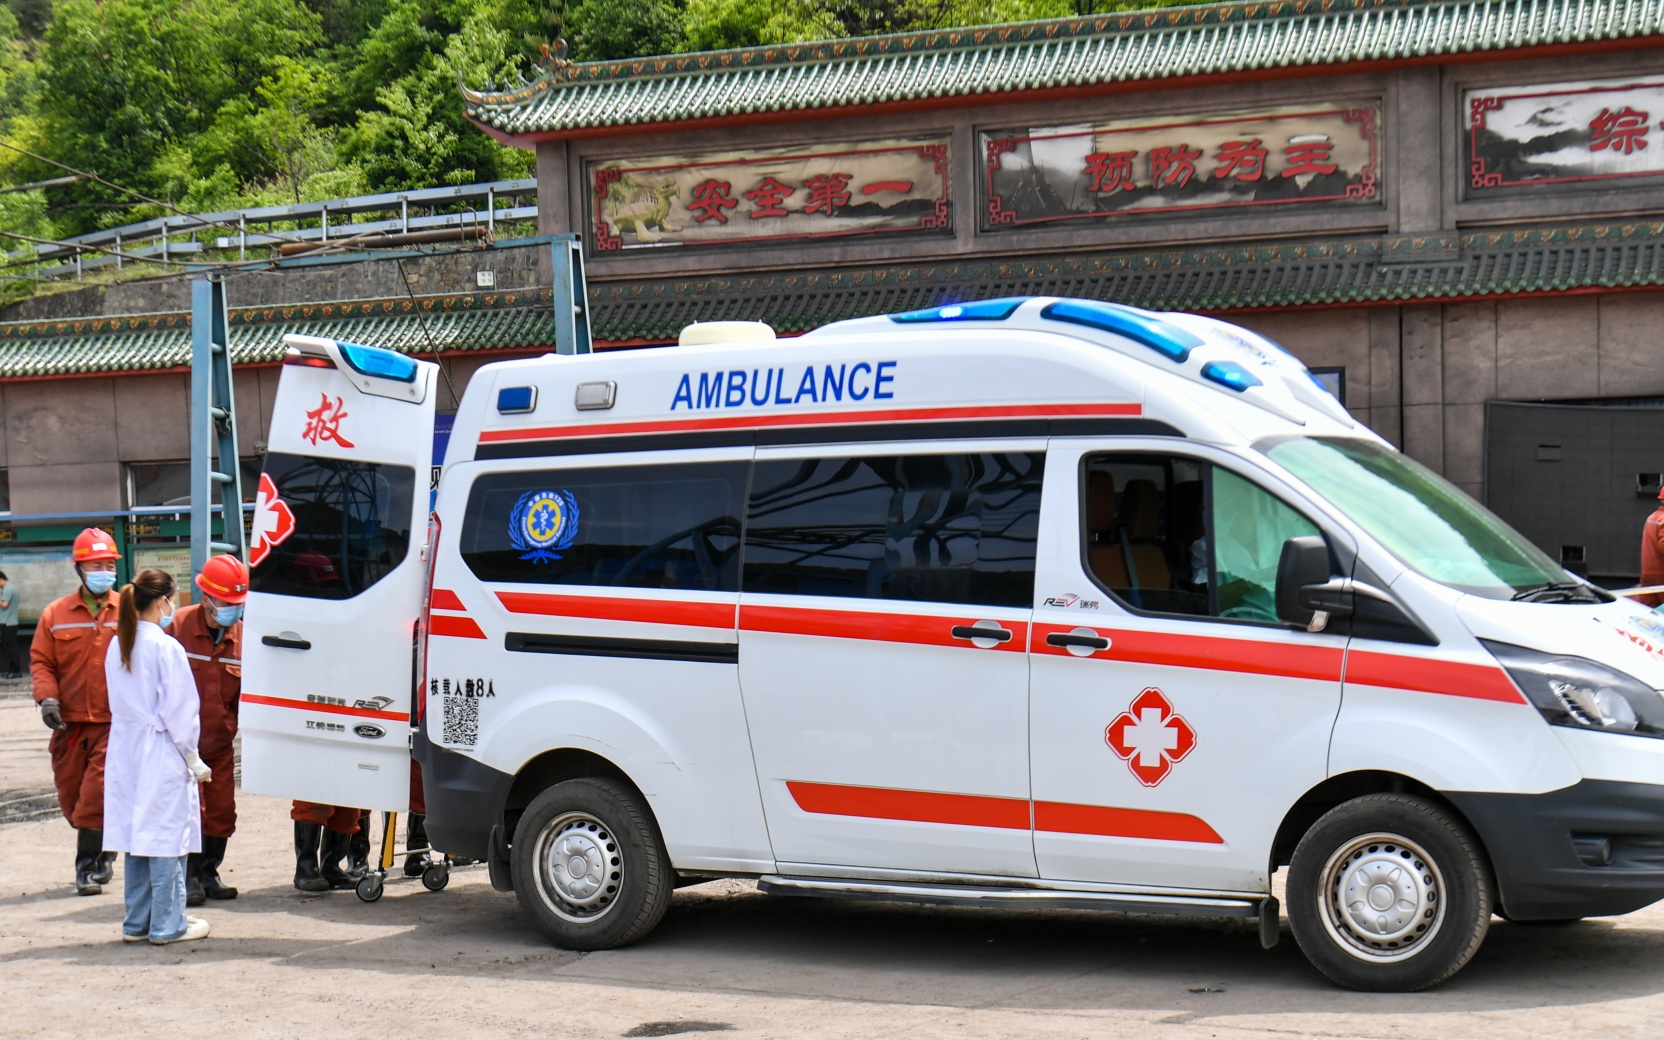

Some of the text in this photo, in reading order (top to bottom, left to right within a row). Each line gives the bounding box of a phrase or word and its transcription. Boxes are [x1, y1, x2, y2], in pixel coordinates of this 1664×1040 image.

[1589, 105, 1664, 155] 综
[688, 172, 913, 223] 安全第一
[670, 360, 897, 411] AMBULANCE
[302, 391, 355, 449] 救
